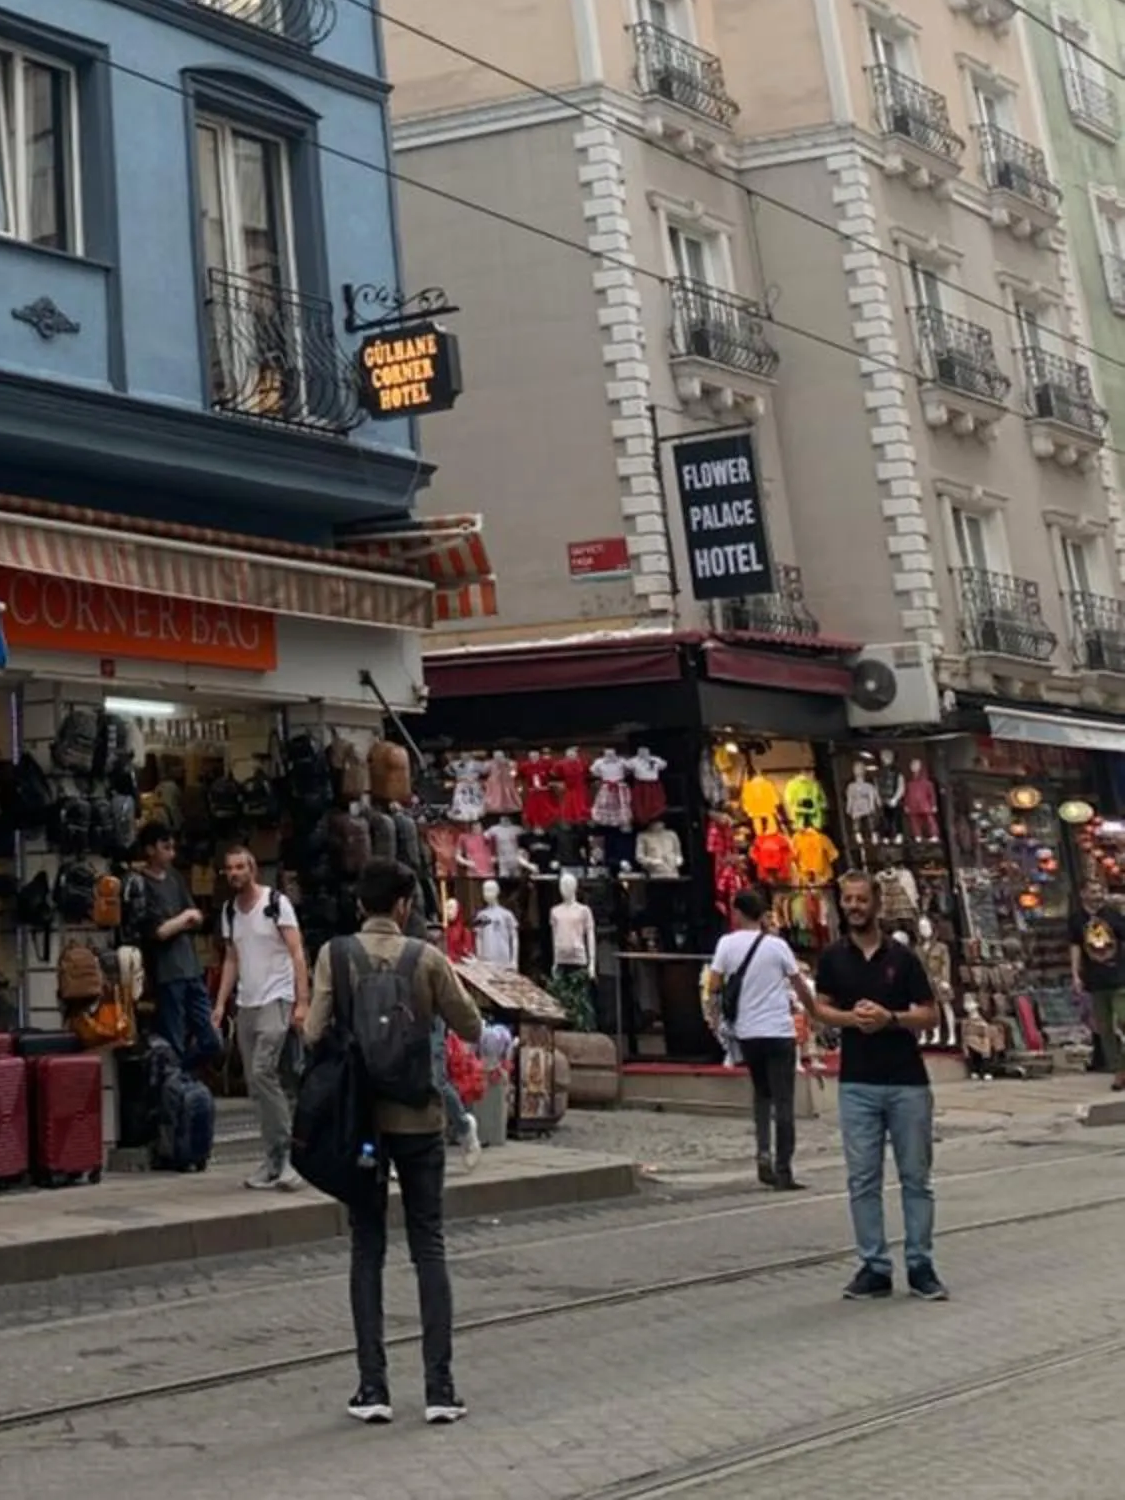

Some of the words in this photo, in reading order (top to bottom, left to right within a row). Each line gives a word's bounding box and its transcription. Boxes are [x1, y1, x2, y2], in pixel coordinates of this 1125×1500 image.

[364, 334, 437, 367] GÜLHANE
[371, 358, 434, 388] CORNER
[380, 382, 431, 410] HOTEL
[682, 457, 751, 490] FLOWER
[690, 500, 756, 531] PALACE
[695, 543, 764, 578] HOTEL
[9, 573, 183, 642] CORNER
[191, 600, 260, 650] BAG
